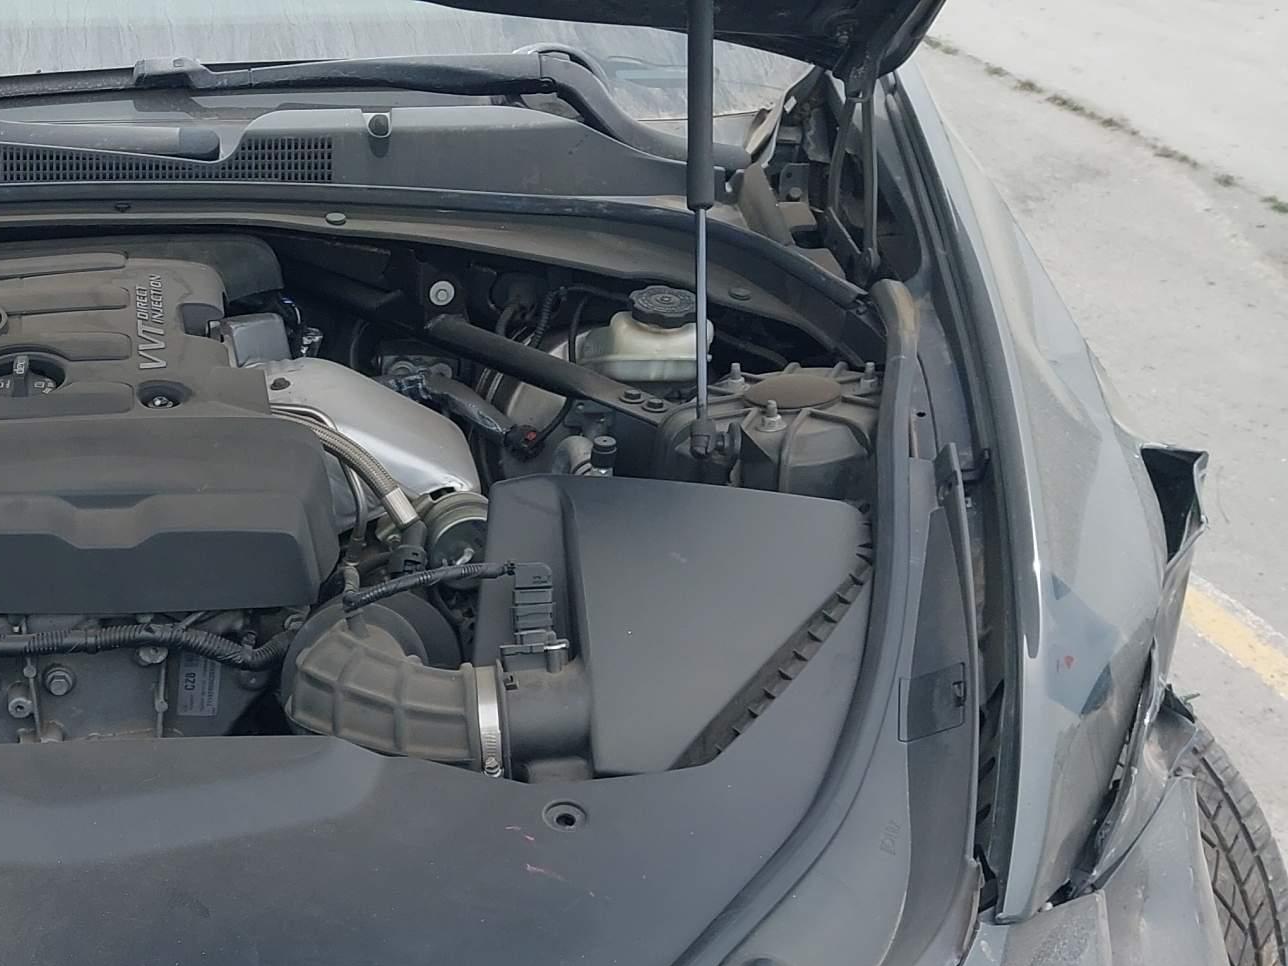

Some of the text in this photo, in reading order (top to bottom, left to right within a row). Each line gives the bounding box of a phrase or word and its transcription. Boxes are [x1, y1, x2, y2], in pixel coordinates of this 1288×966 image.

[136, 285, 149, 321] DIRECT
[149, 273, 165, 325] INJECTION
[137, 319, 166, 370] VVT
